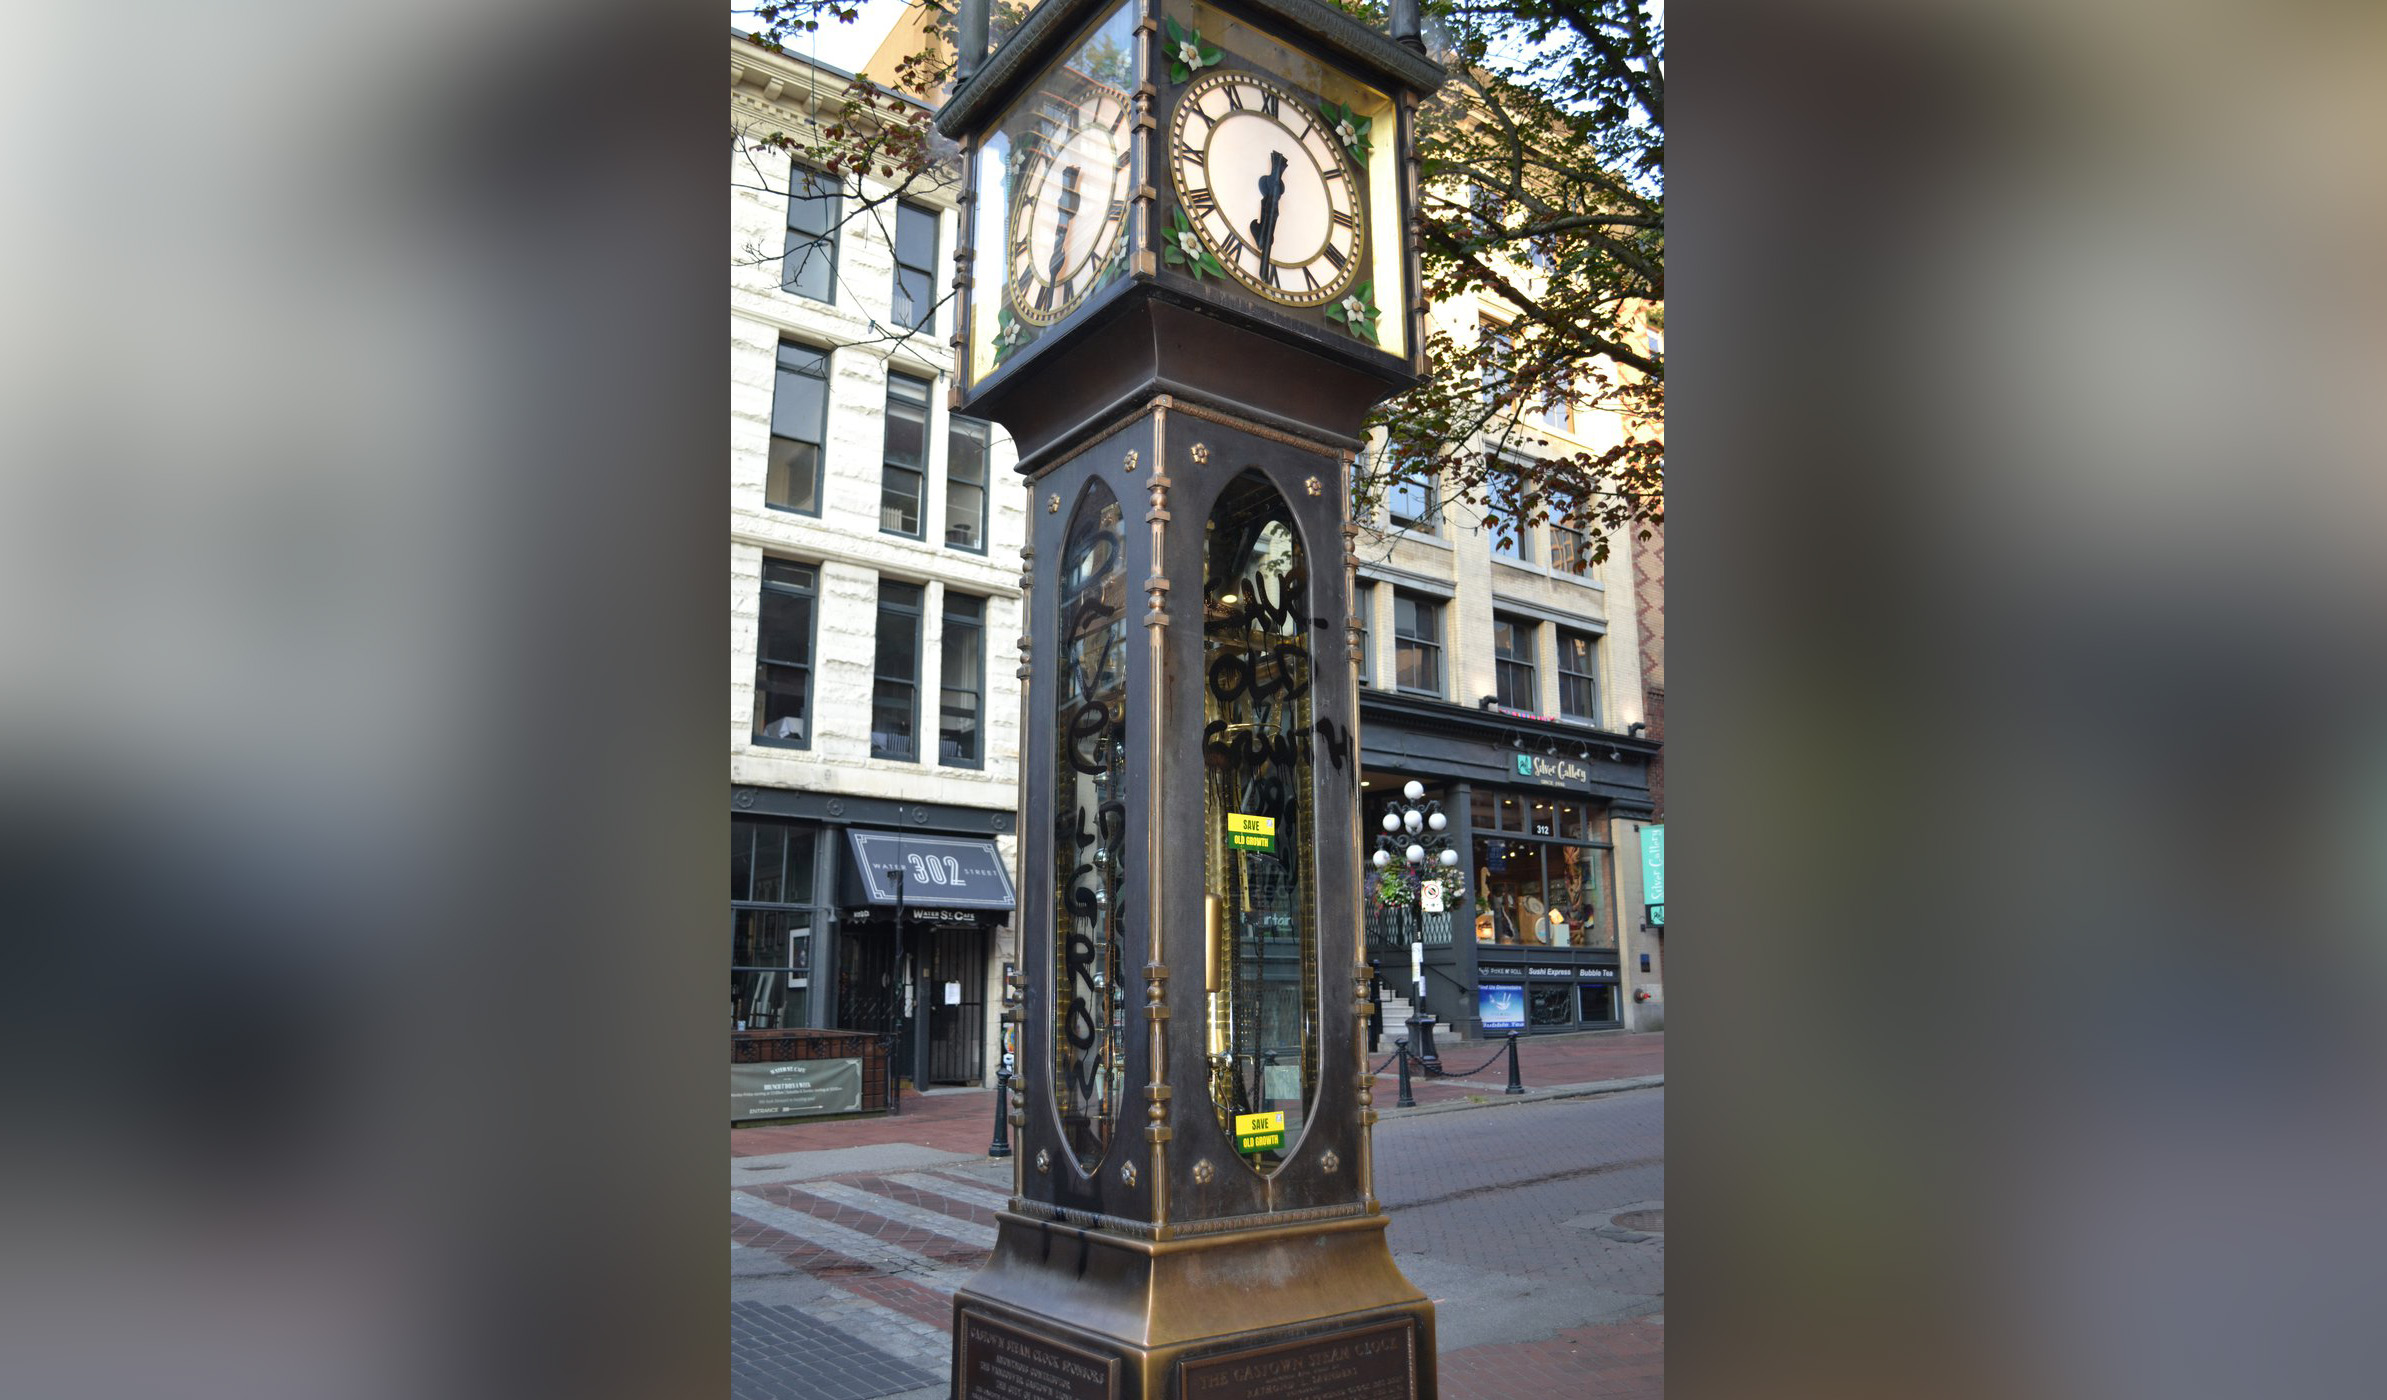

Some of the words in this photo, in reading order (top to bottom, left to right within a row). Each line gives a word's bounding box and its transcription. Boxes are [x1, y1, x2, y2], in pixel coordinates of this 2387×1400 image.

[1533, 757, 1556, 776] Silver
[1558, 761, 1587, 783] Gallery
[1243, 819, 1260, 831] SAVE
[1536, 825, 1550, 835] 312
[1234, 835, 1245, 845] OLD
[1246, 836, 1269, 848] GROWTH
[872, 862, 906, 871] WATER
[908, 853, 966, 887] 302
[964, 868, 997, 877] STREET
[1528, 967, 1546, 975] Sushi
[1547, 968, 1571, 977] Express
[1580, 968, 1601, 977] Bubble
[1603, 969, 1613, 977] Tea
[749, 1107, 779, 1115] ENTRANCE
[1252, 1118, 1269, 1130] SAVE
[1243, 1137, 1254, 1148] OLD
[1255, 1134, 1279, 1147] GROWTH
[1200, 1374, 1228, 1390] THE
[1234, 1360, 1303, 1382] GASTOWN
